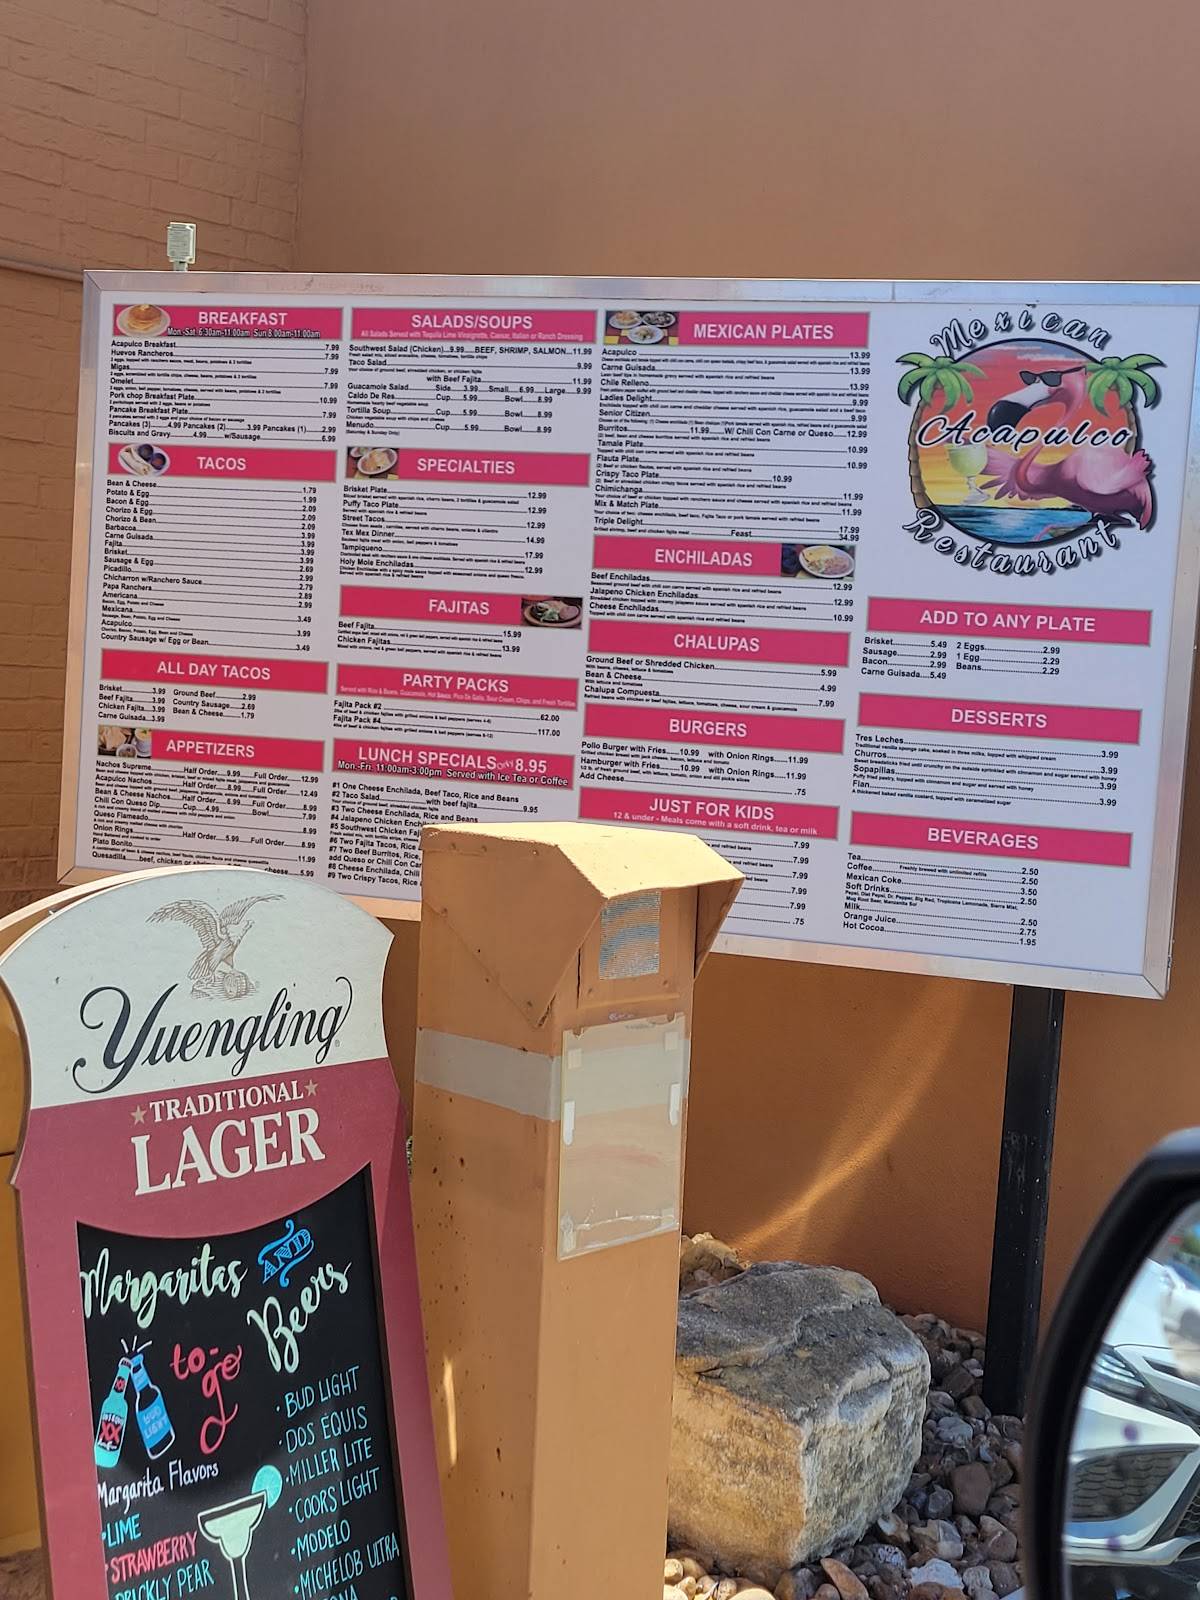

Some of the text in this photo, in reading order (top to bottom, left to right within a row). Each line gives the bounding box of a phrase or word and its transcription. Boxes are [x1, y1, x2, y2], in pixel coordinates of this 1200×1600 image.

[198, 312, 288, 326] BREAKFAST
[411, 315, 533, 329] SALADS/SOUPS
[693, 324, 834, 340] MEXICAN PLATES
[930, 310, 1112, 358] Mexican
[111, 340, 143, 349] Acapulco
[144, 340, 176, 348] Breakfast
[349, 344, 386, 353] Southwest
[388, 345, 408, 353] Salad
[410, 345, 444, 354] (Chicken)
[449, 346, 465, 354] 9.99
[533, 347, 567, 355] SALMON
[602, 349, 871, 360] Acapulco 13.99
[916, 412, 1131, 452] Acapulco
[197, 457, 247, 471] TACOS
[417, 458, 516, 474] SPECIALTIES
[901, 507, 1120, 578] Restaurant
[654, 549, 753, 567] ENCHILADAS
[428, 599, 490, 615] FAJITAS
[920, 609, 1096, 633] ADD TO ANY PLATE
[673, 633, 760, 652] CHALUPAS
[864, 637, 1060, 655] Brisket 5.49 2 Eggs 2.99
[862, 657, 1060, 675] Bacon 2.99 Beans 2.29
[863, 648, 898, 658] Sausage
[930, 651, 947, 659] 2.99
[964, 653, 980, 663] Egg
[1043, 657, 1060, 666] 2.29
[157, 661, 271, 680] ALL DAY TACOS
[861, 668, 946, 680] Carne Guisada 5.49
[403, 674, 509, 692] PARTY PACKS
[669, 719, 747, 737] BURGERS
[951, 708, 1048, 728] DESSERTS
[167, 739, 255, 758] APPETIZERS
[581, 741, 601, 750] Pollo
[603, 742, 628, 752] Burger
[648, 745, 666, 754] Fries
[679, 748, 700, 756] 10.99
[708, 750, 724, 758] with
[726, 751, 750, 760] Onion
[752, 752, 774, 762] Rings
[788, 756, 808, 764] 11.99
[855, 734, 1119, 759] Tres Leches 3.99
[358, 746, 547, 774] LUNCH SPECIALS 8.95
[854, 749, 1118, 775] Churros 3.99
[376, 762, 442, 776] 11:00am-3:00pm
[446, 769, 475, 779] Served
[477, 771, 495, 780] with
[497, 772, 509, 781] Ice
[512, 773, 527, 783] Tea
[530, 775, 539, 783] or
[541, 776, 568, 786] Coffee
[853, 764, 1117, 791] Sopapillas 3.99
[852, 780, 1116, 807] Flan 3.99
[649, 798, 775, 820] JUST FOR KIDS
[624, 812, 630, 820] &
[631, 812, 655, 822] under
[661, 815, 683, 825] Meals
[685, 819, 707, 827] come
[709, 820, 725, 828] with
[733, 821, 749, 830] soft
[800, 827, 817, 835] milk
[927, 828, 1039, 849] BEVERAGES
[847, 853, 1039, 876] Tea 2.50
[847, 863, 1038, 885] Coffee 2.50
[846, 872, 1038, 896] Mexican Coke 3.50
[846, 882, 1037, 906] Soft Drinks 2.50
[843, 912, 1037, 936] Orange Juice 2.75
[844, 902, 1038, 927] Milk 2.50
[843, 921, 1036, 946] Hot Cocoa 1.95
[72, 975, 353, 1094] Yuengling
[150, 1079, 304, 1122] TRADITIONAL
[131, 1107, 325, 1197] LAGER
[262, 1226, 312, 1284] AND
[80, 1243, 249, 1329] Margaritas
[247, 1261, 352, 1373] Beers
[285, 1365, 360, 1418] BUD LIGHT
[100, 1423, 121, 1443] XX
[286, 1405, 368, 1454] DOS EQUIS
[289, 1437, 373, 1487] MILLER LITE
[98, 1460, 219, 1514] Margarita Flavors
[295, 1466, 380, 1524] COORS LIGHT
[107, 1514, 141, 1548] LIME
[297, 1519, 350, 1562] MODELO
[111, 1531, 197, 1582] STRAWBERRY
[300, 1532, 400, 1600] MICHELOB ULTRA
[177, 1560, 215, 1596] PEAR
